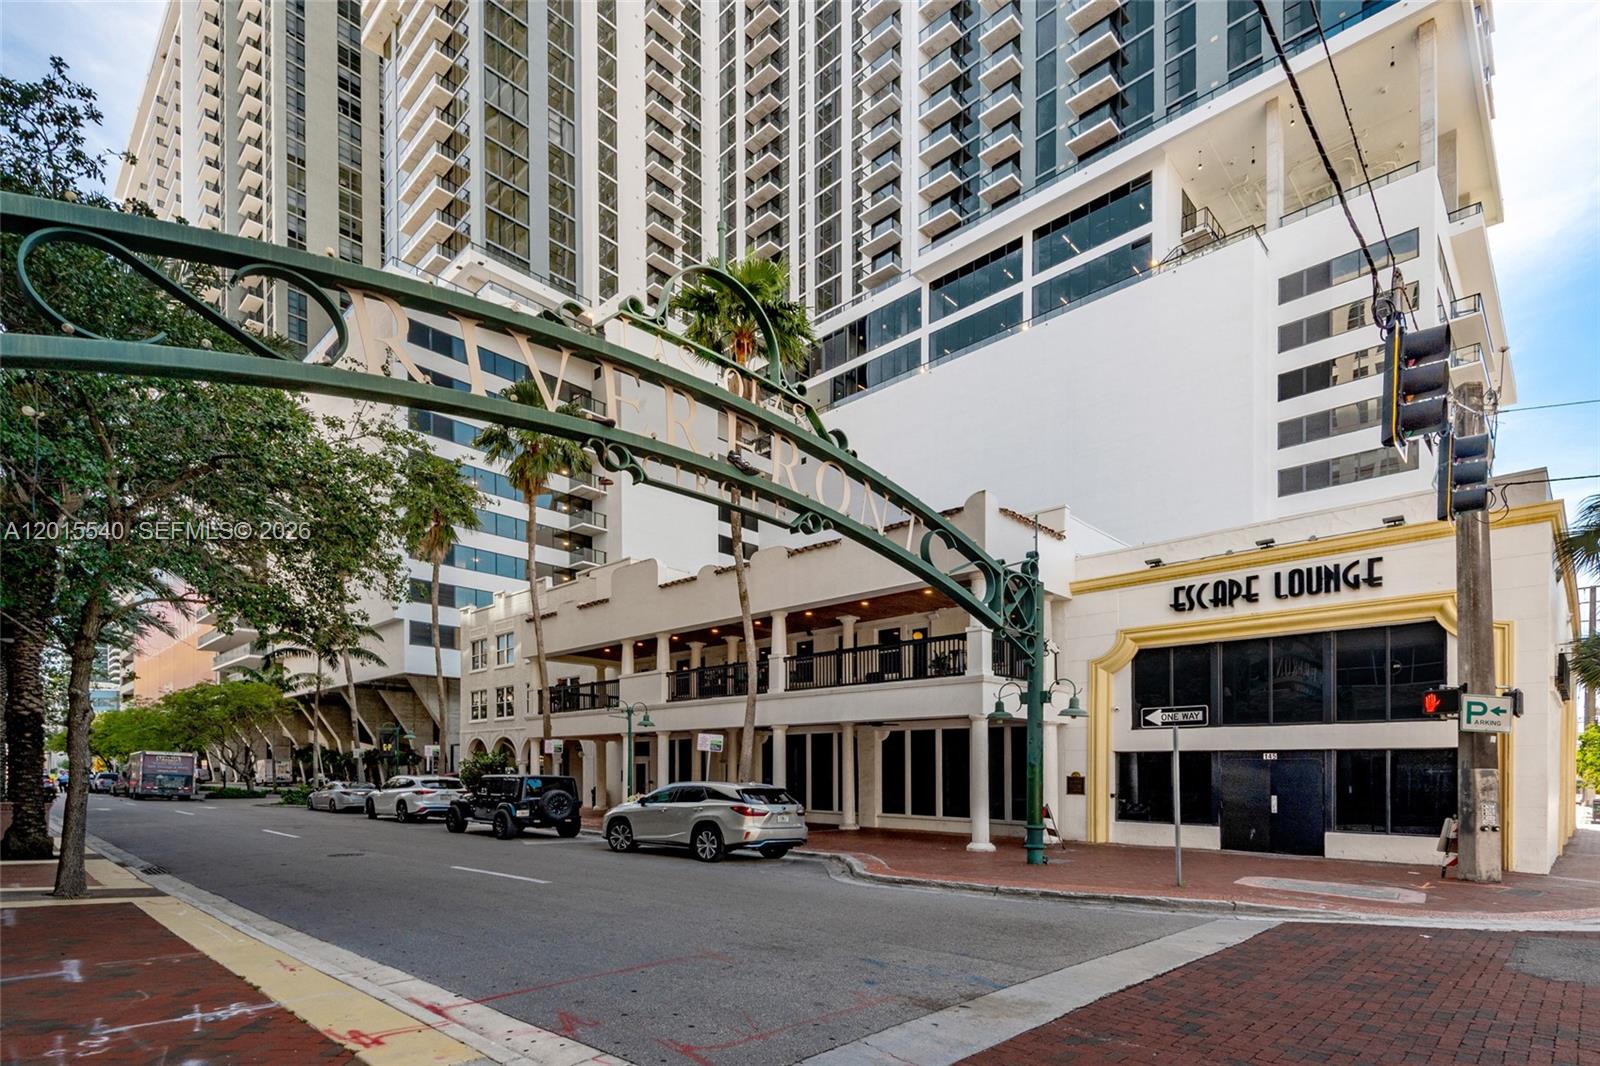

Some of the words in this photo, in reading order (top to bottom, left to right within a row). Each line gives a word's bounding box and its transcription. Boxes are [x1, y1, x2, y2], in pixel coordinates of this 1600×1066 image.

[617, 315, 698, 374] LAS
[723, 367, 809, 431] OLAS
[335, 283, 924, 552] RIVERFRONT
[1169, 574, 1260, 612] ESCAPE
[1274, 556, 1384, 600] LOUNGE
[1160, 712, 1180, 721] ONE
[1181, 711, 1200, 720] WAY
